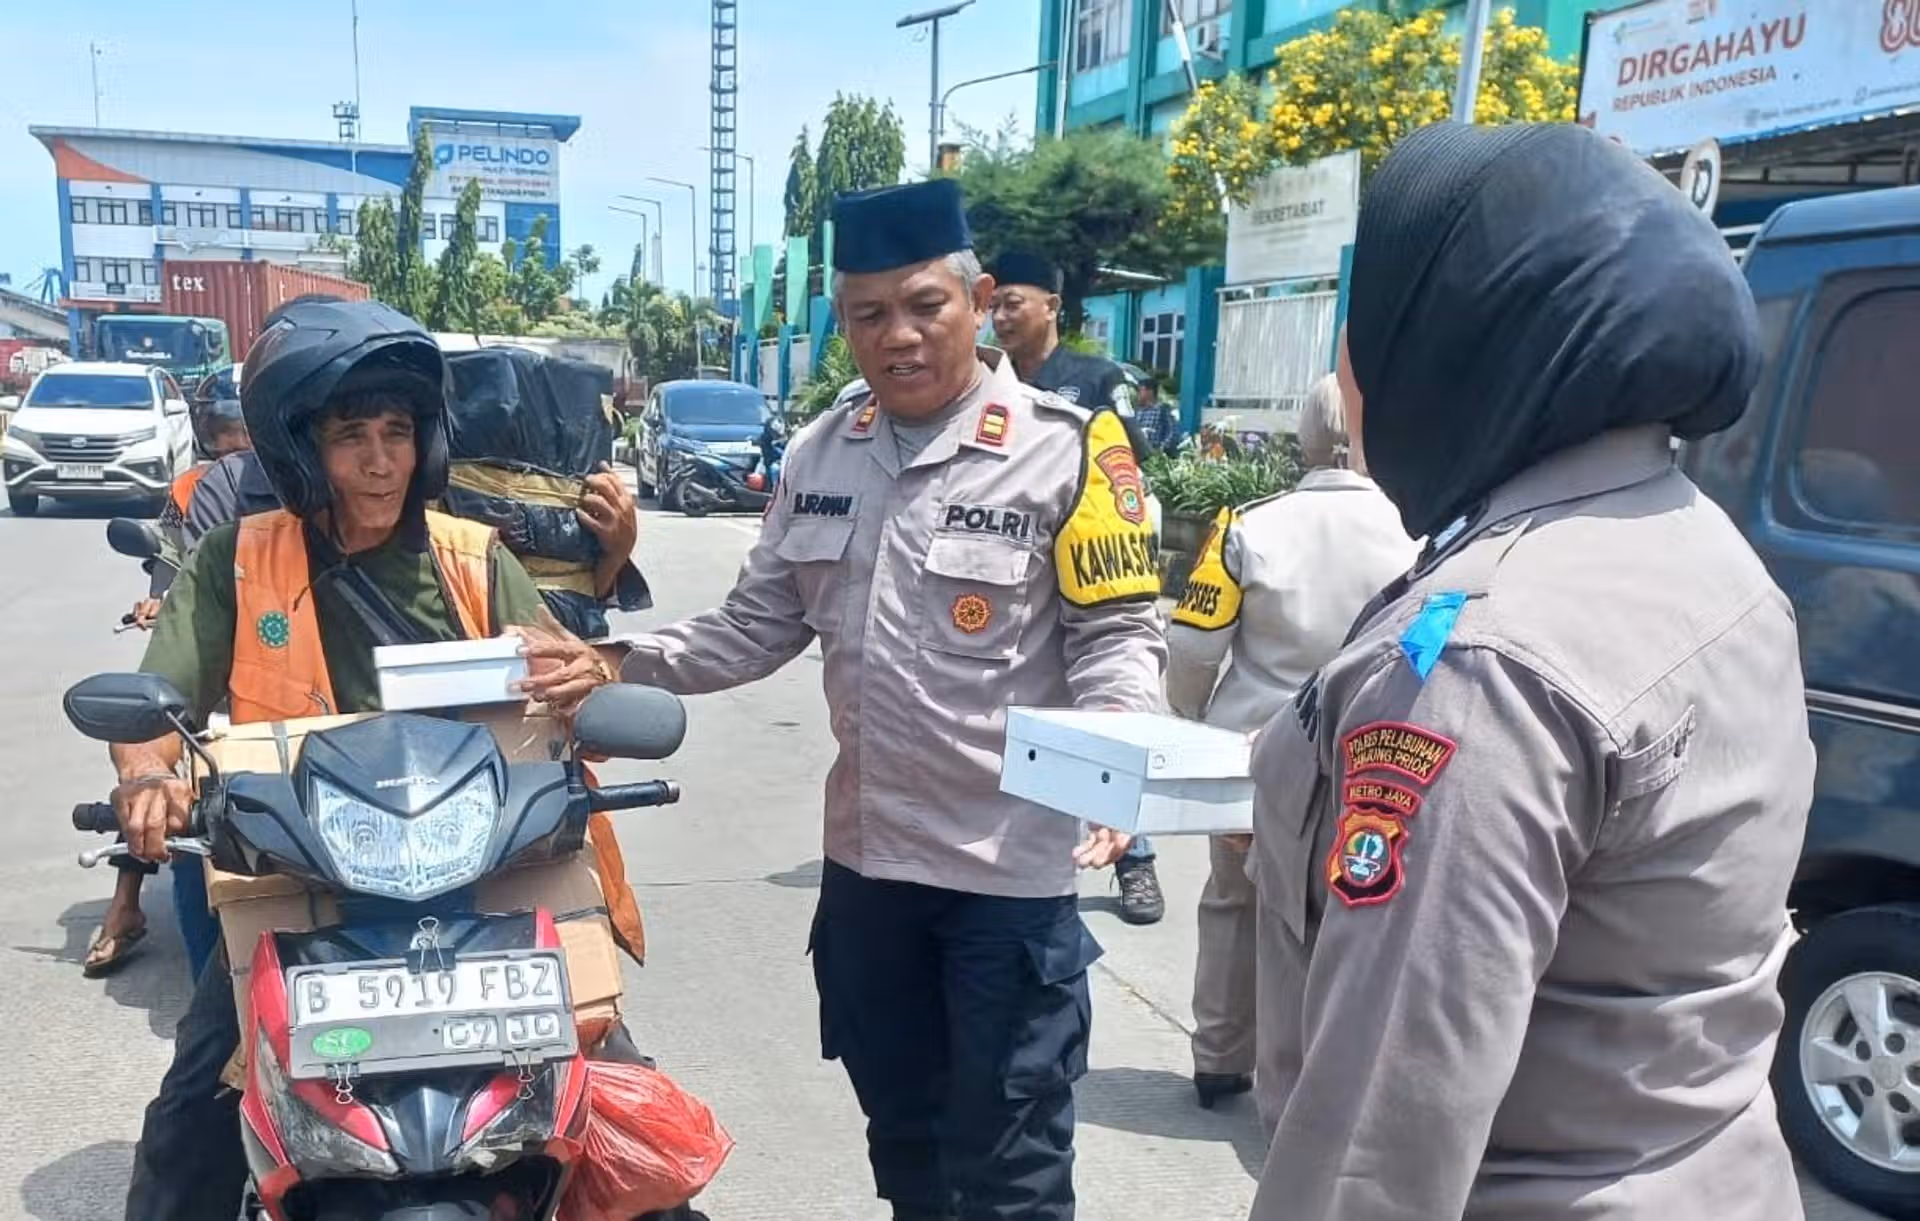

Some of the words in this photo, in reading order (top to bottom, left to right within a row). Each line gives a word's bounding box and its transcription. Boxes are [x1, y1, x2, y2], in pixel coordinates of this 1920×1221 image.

[1617, 13, 1806, 87] DIRGAHAYU
[1613, 80, 1684, 112] REPUBLIK
[1688, 65, 1777, 97] INDONESIA
[458, 144, 551, 166] PELINDO
[172, 272, 205, 292] tex
[945, 503, 1031, 538] POLRI
[1380, 729, 1446, 764] PELABUHAN
[1393, 751, 1431, 777] PRIOK
[1384, 788, 1411, 808] JAYA
[307, 981, 330, 1013] B
[358, 971, 457, 1009] 5919
[480, 962, 552, 1000] FBZ
